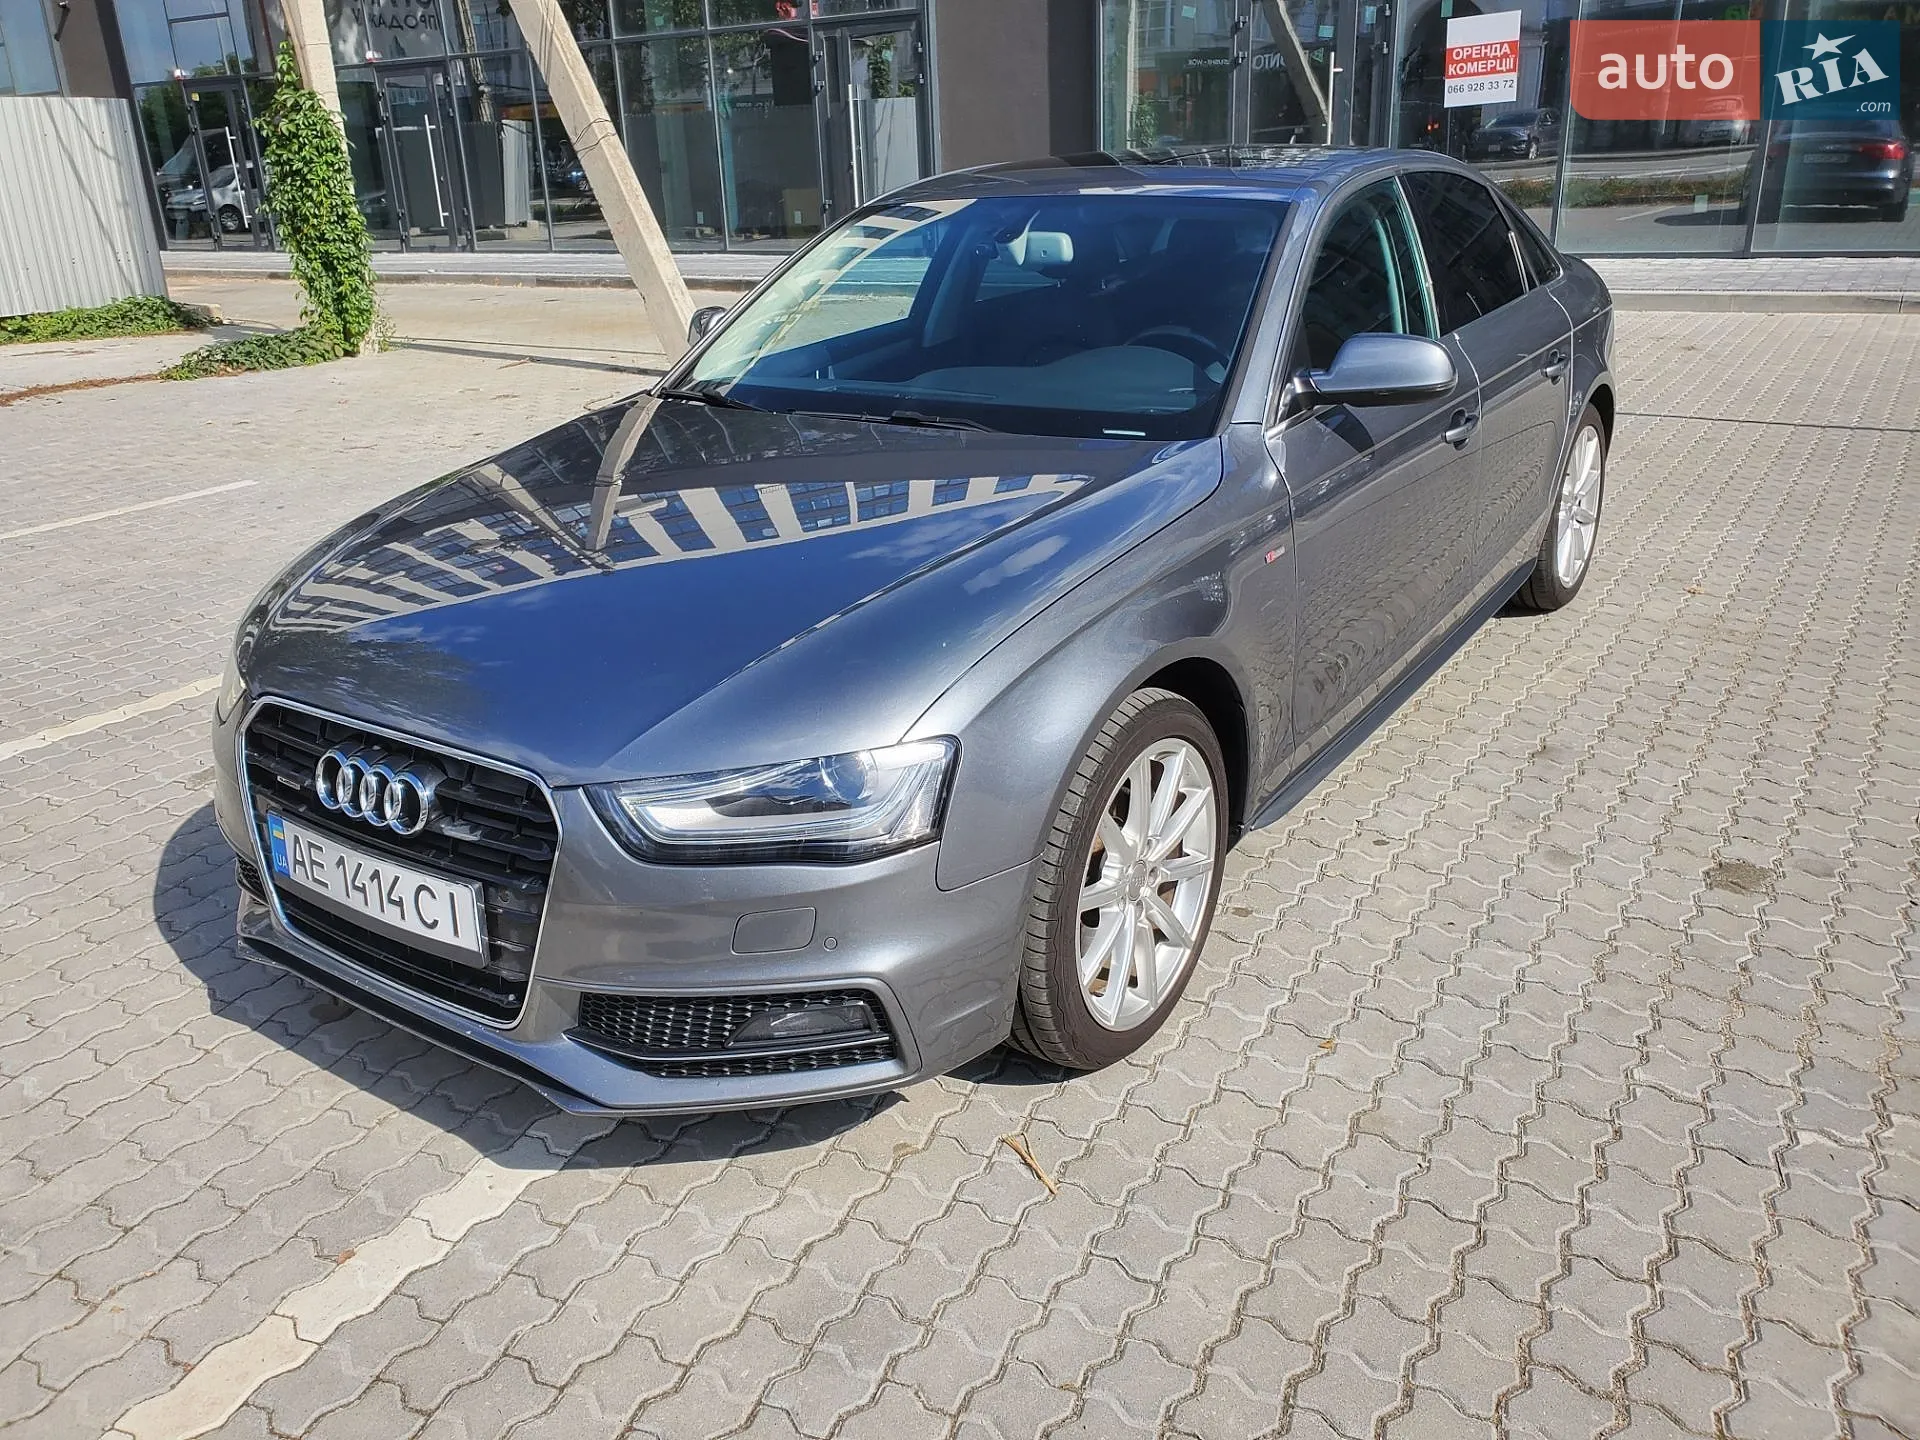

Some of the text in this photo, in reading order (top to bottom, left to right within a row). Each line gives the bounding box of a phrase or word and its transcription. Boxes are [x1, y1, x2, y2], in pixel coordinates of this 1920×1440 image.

[1452, 43, 1511, 60] ОРЕНДА
[1448, 55, 1515, 76] КОМЕРЦІЇ
[1447, 79, 1514, 94] 066 928 33 72
[275, 851, 288, 868] UA
[292, 834, 330, 890] AE
[336, 855, 407, 921] 1414
